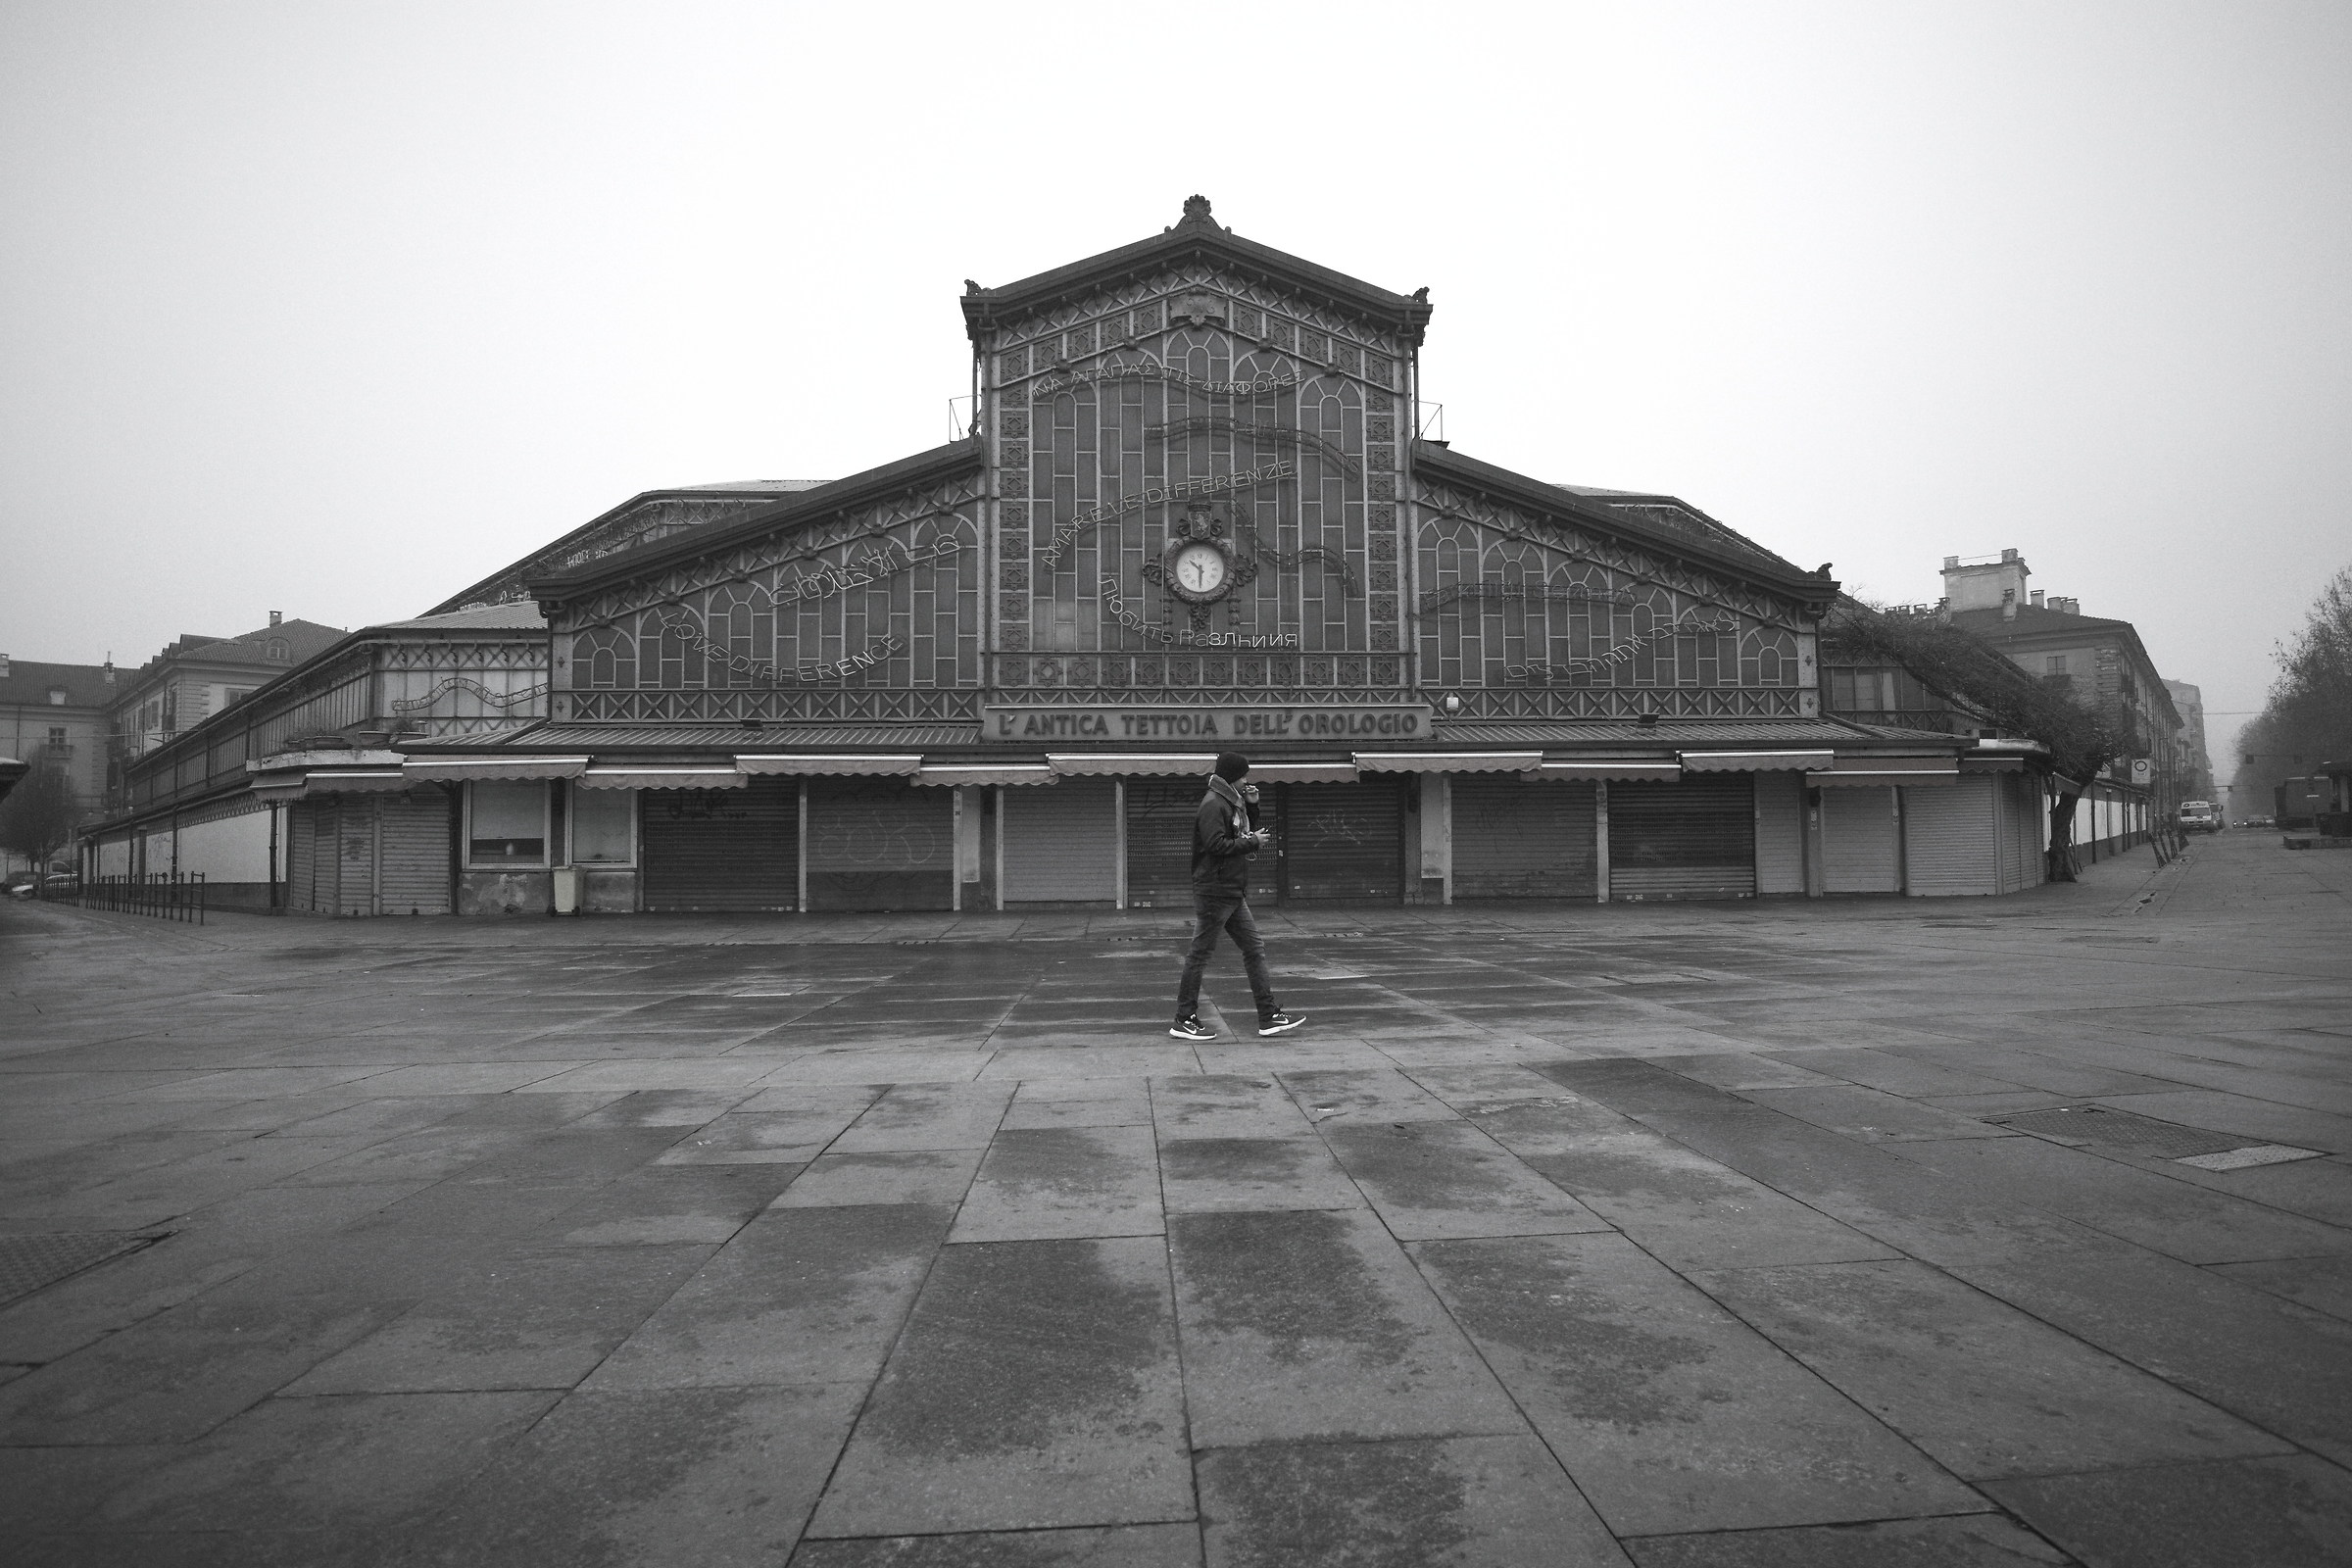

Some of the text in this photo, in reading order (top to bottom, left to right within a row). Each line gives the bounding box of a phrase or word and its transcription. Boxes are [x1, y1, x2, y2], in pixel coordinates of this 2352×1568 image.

[1042, 507, 1110, 567] AMARE
[1146, 460, 1295, 504] DIFFERENZE
[660, 612, 729, 663] LOVE
[1023, 713, 1109, 737] ANTICA
[1120, 713, 1218, 737] TETTOIA
[1298, 712, 1420, 735] OROLOGIO
